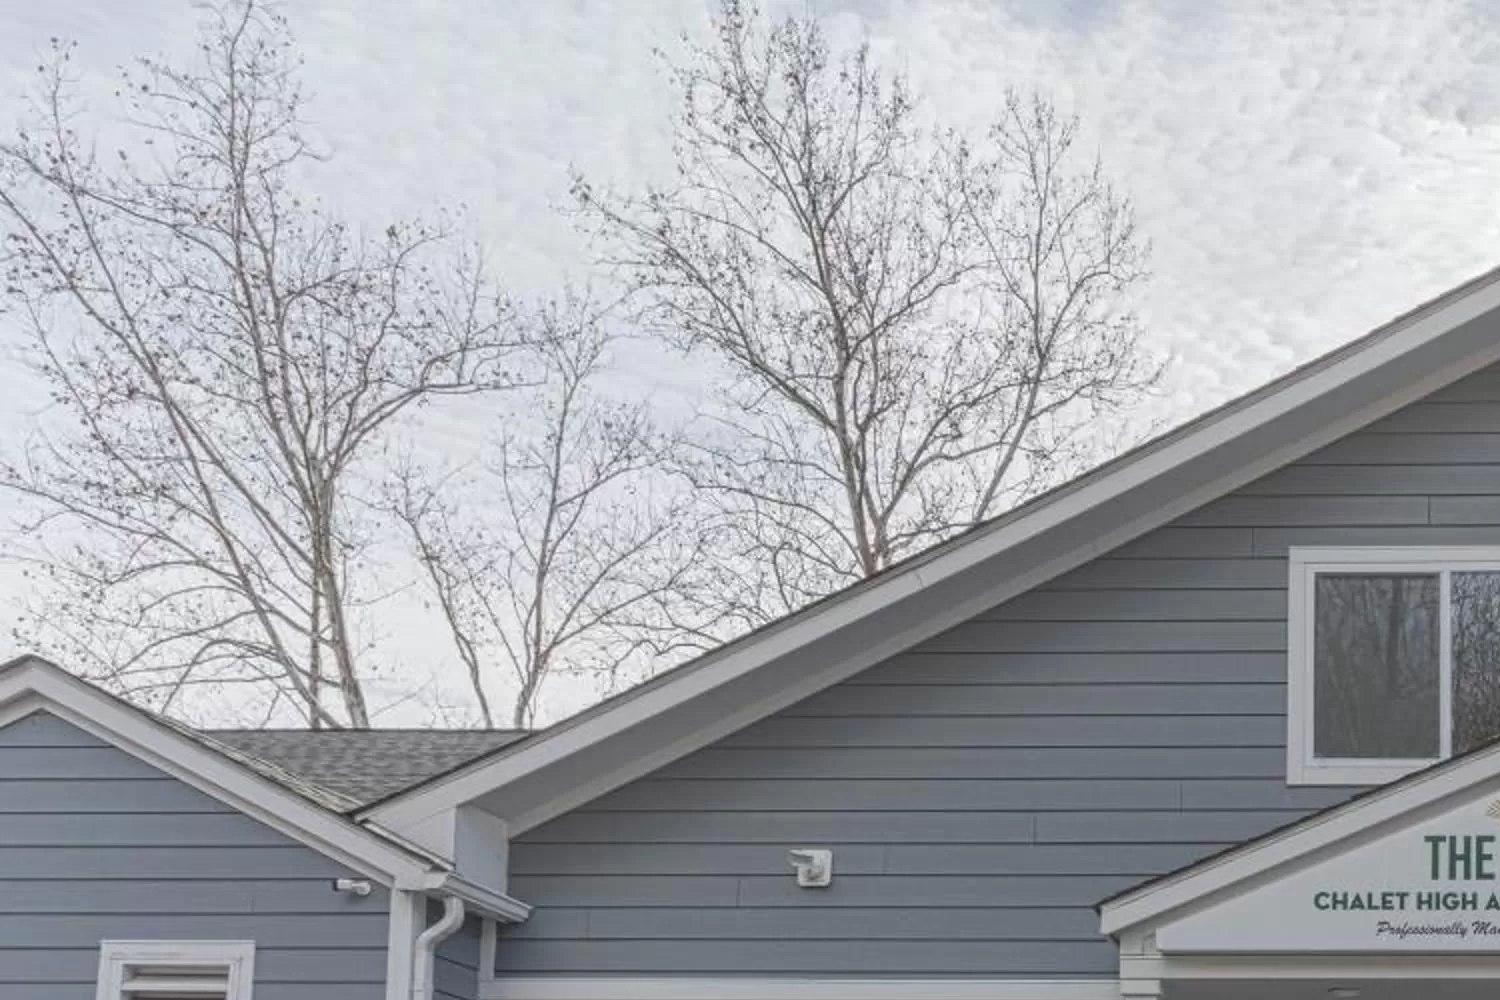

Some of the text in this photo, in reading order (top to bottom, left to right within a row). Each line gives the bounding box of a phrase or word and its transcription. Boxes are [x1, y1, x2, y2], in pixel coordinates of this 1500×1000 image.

[1424, 834, 1496, 881] THE
[1313, 890, 1410, 912] CHALET
[1416, 890, 1477, 912] HIGH
[1376, 920, 1468, 938] Professionally
